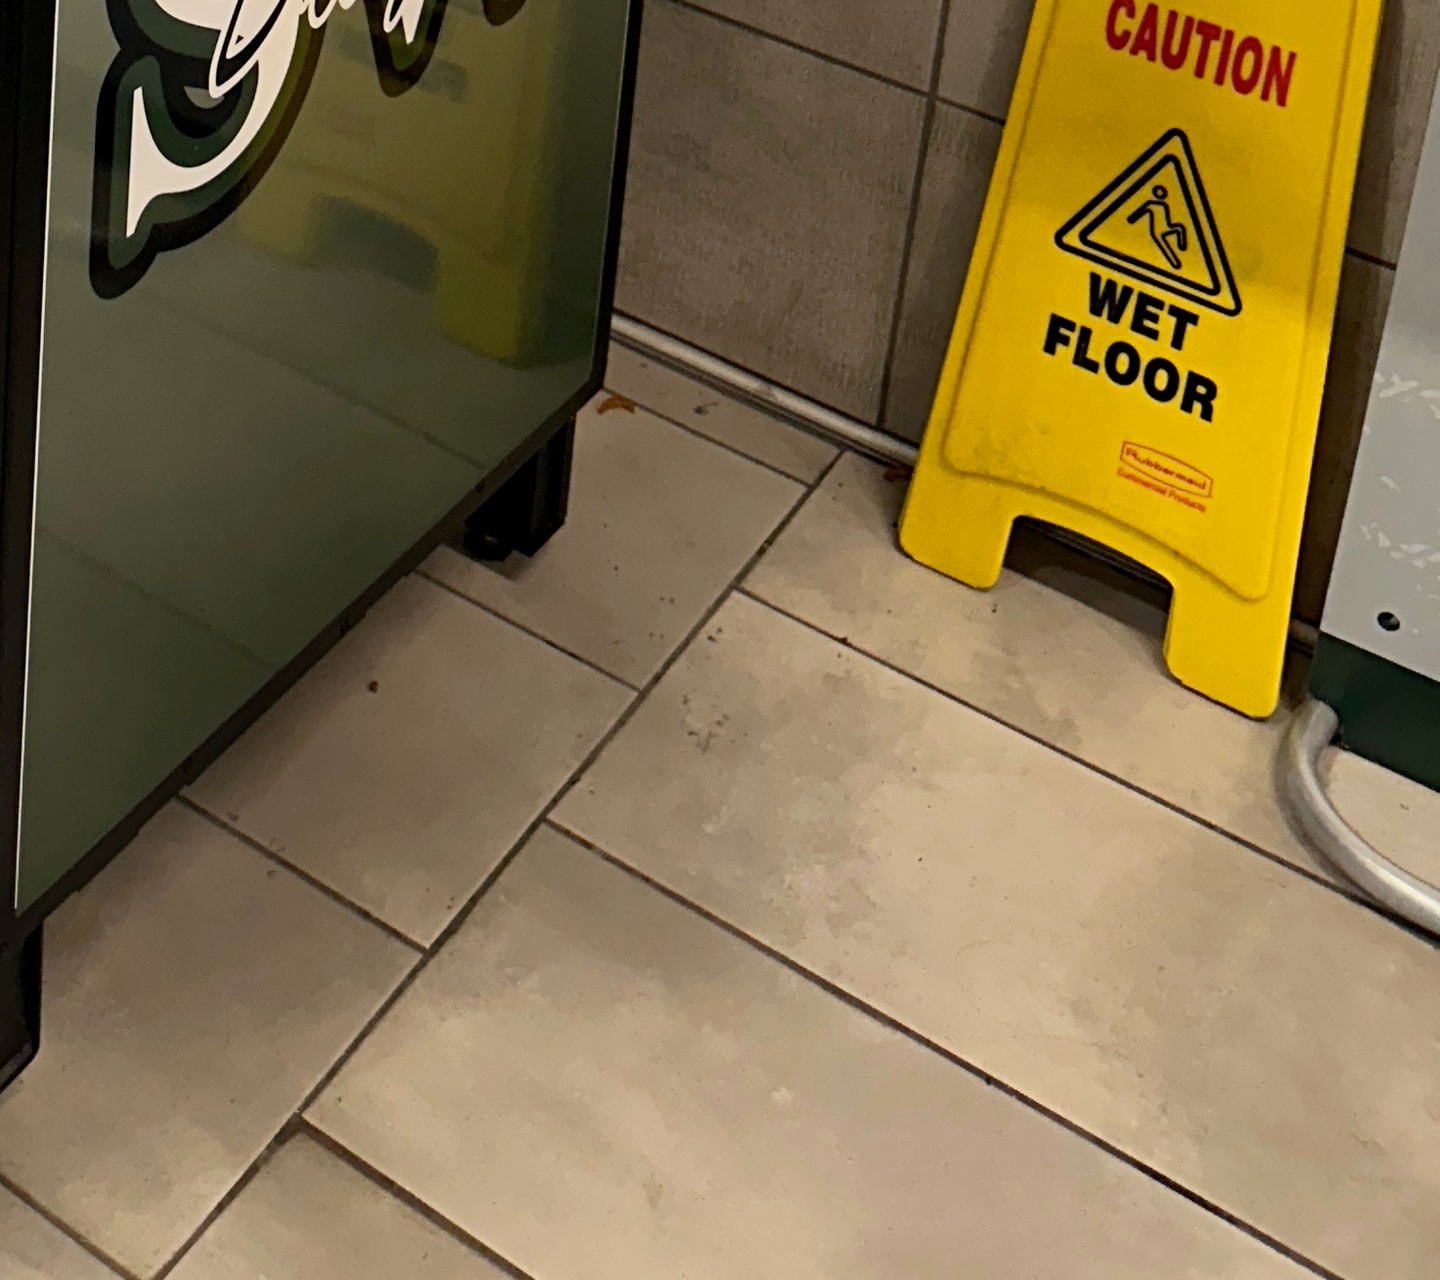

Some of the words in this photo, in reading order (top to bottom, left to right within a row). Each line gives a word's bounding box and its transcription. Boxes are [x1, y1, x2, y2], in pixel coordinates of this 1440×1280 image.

[1088, 272, 1200, 353] WET
[1043, 324, 1219, 424] FLOOR
[1125, 447, 1207, 490] Rubbermaid
